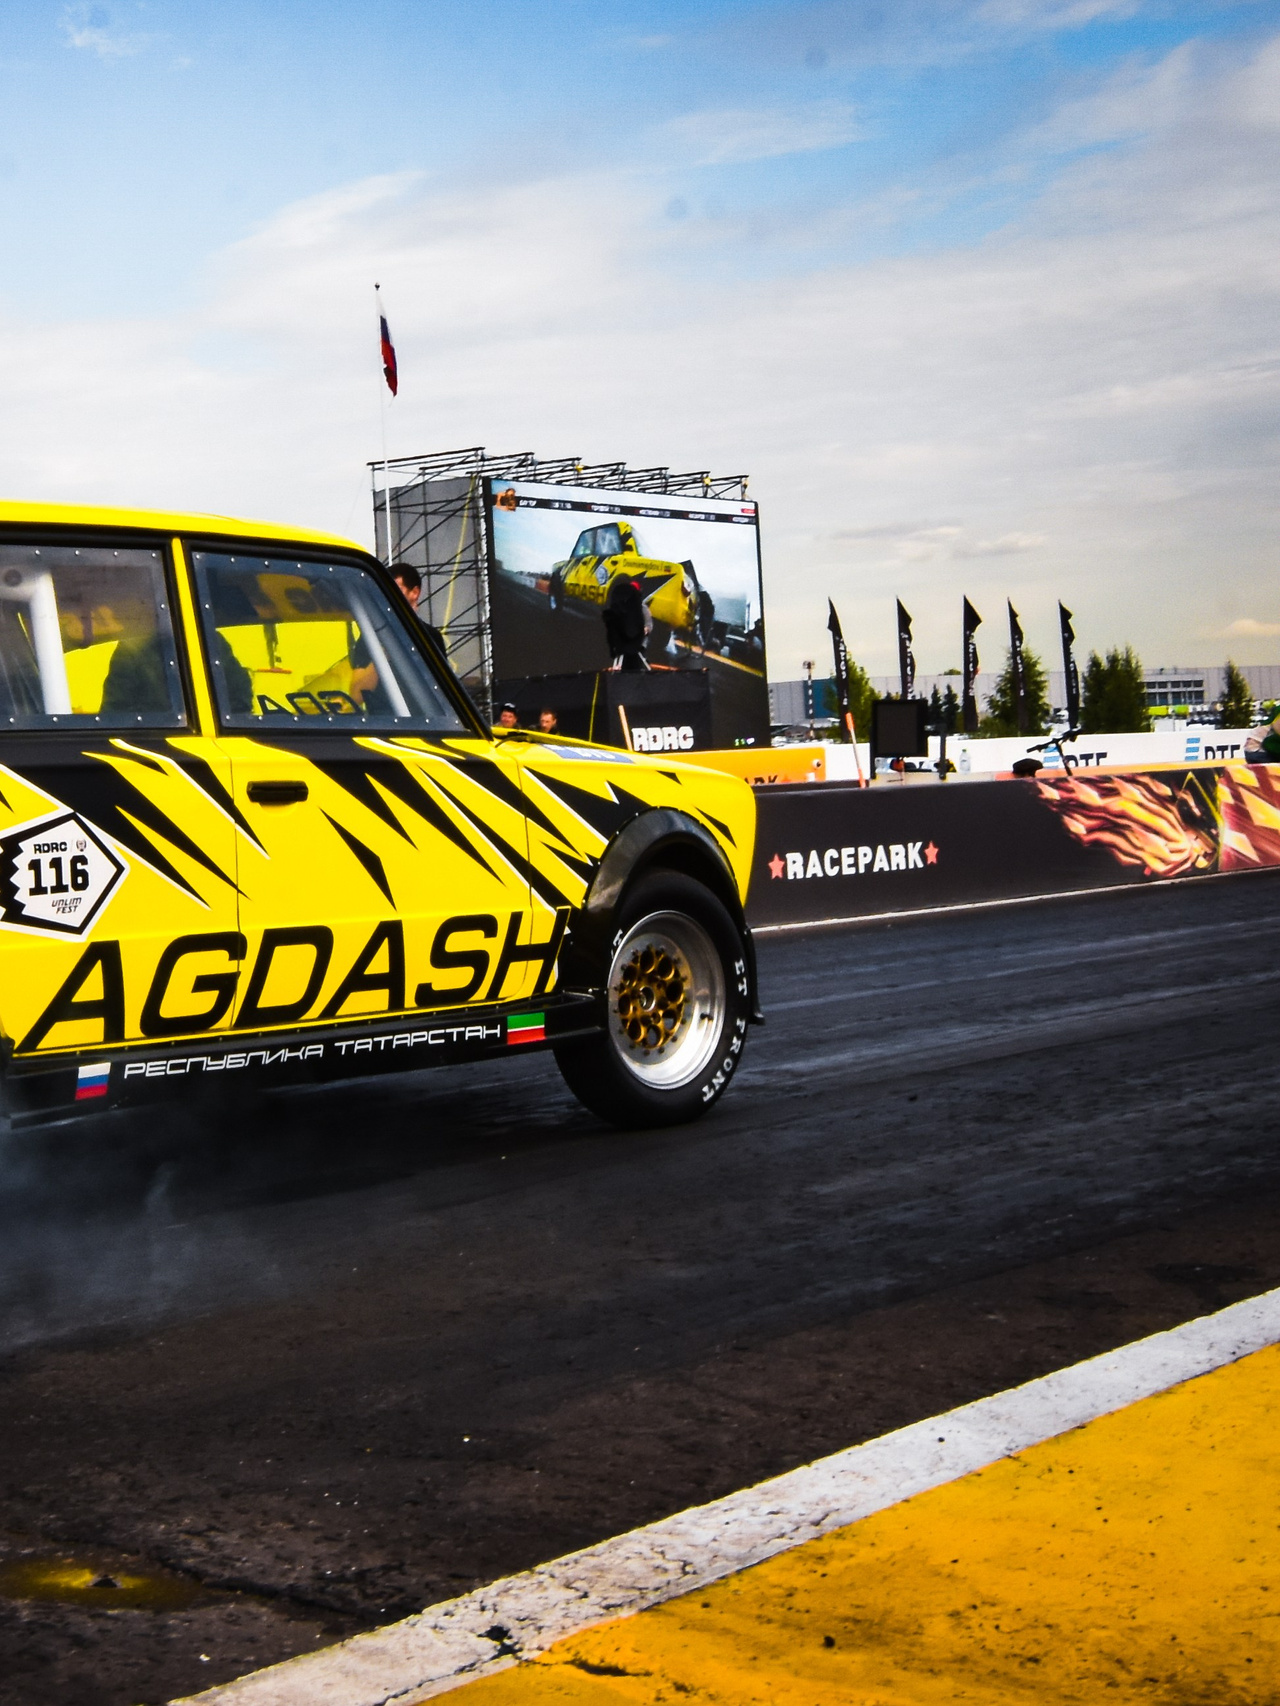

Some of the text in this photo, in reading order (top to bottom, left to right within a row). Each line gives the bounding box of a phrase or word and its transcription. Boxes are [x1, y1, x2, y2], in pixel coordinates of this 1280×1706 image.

[632, 726, 694, 751] RDRC
[33, 842, 68, 854] RDRC
[785, 841, 925, 880] RACEPARK
[28, 855, 90, 896] 116
[56, 906, 79, 914] FEST
[20, 907, 569, 1051] AGDASH
[702, 958, 748, 1102] ET FRONT
[123, 1024, 501, 1079] РЕСПУБЛИКА ТАТАРСТАН
